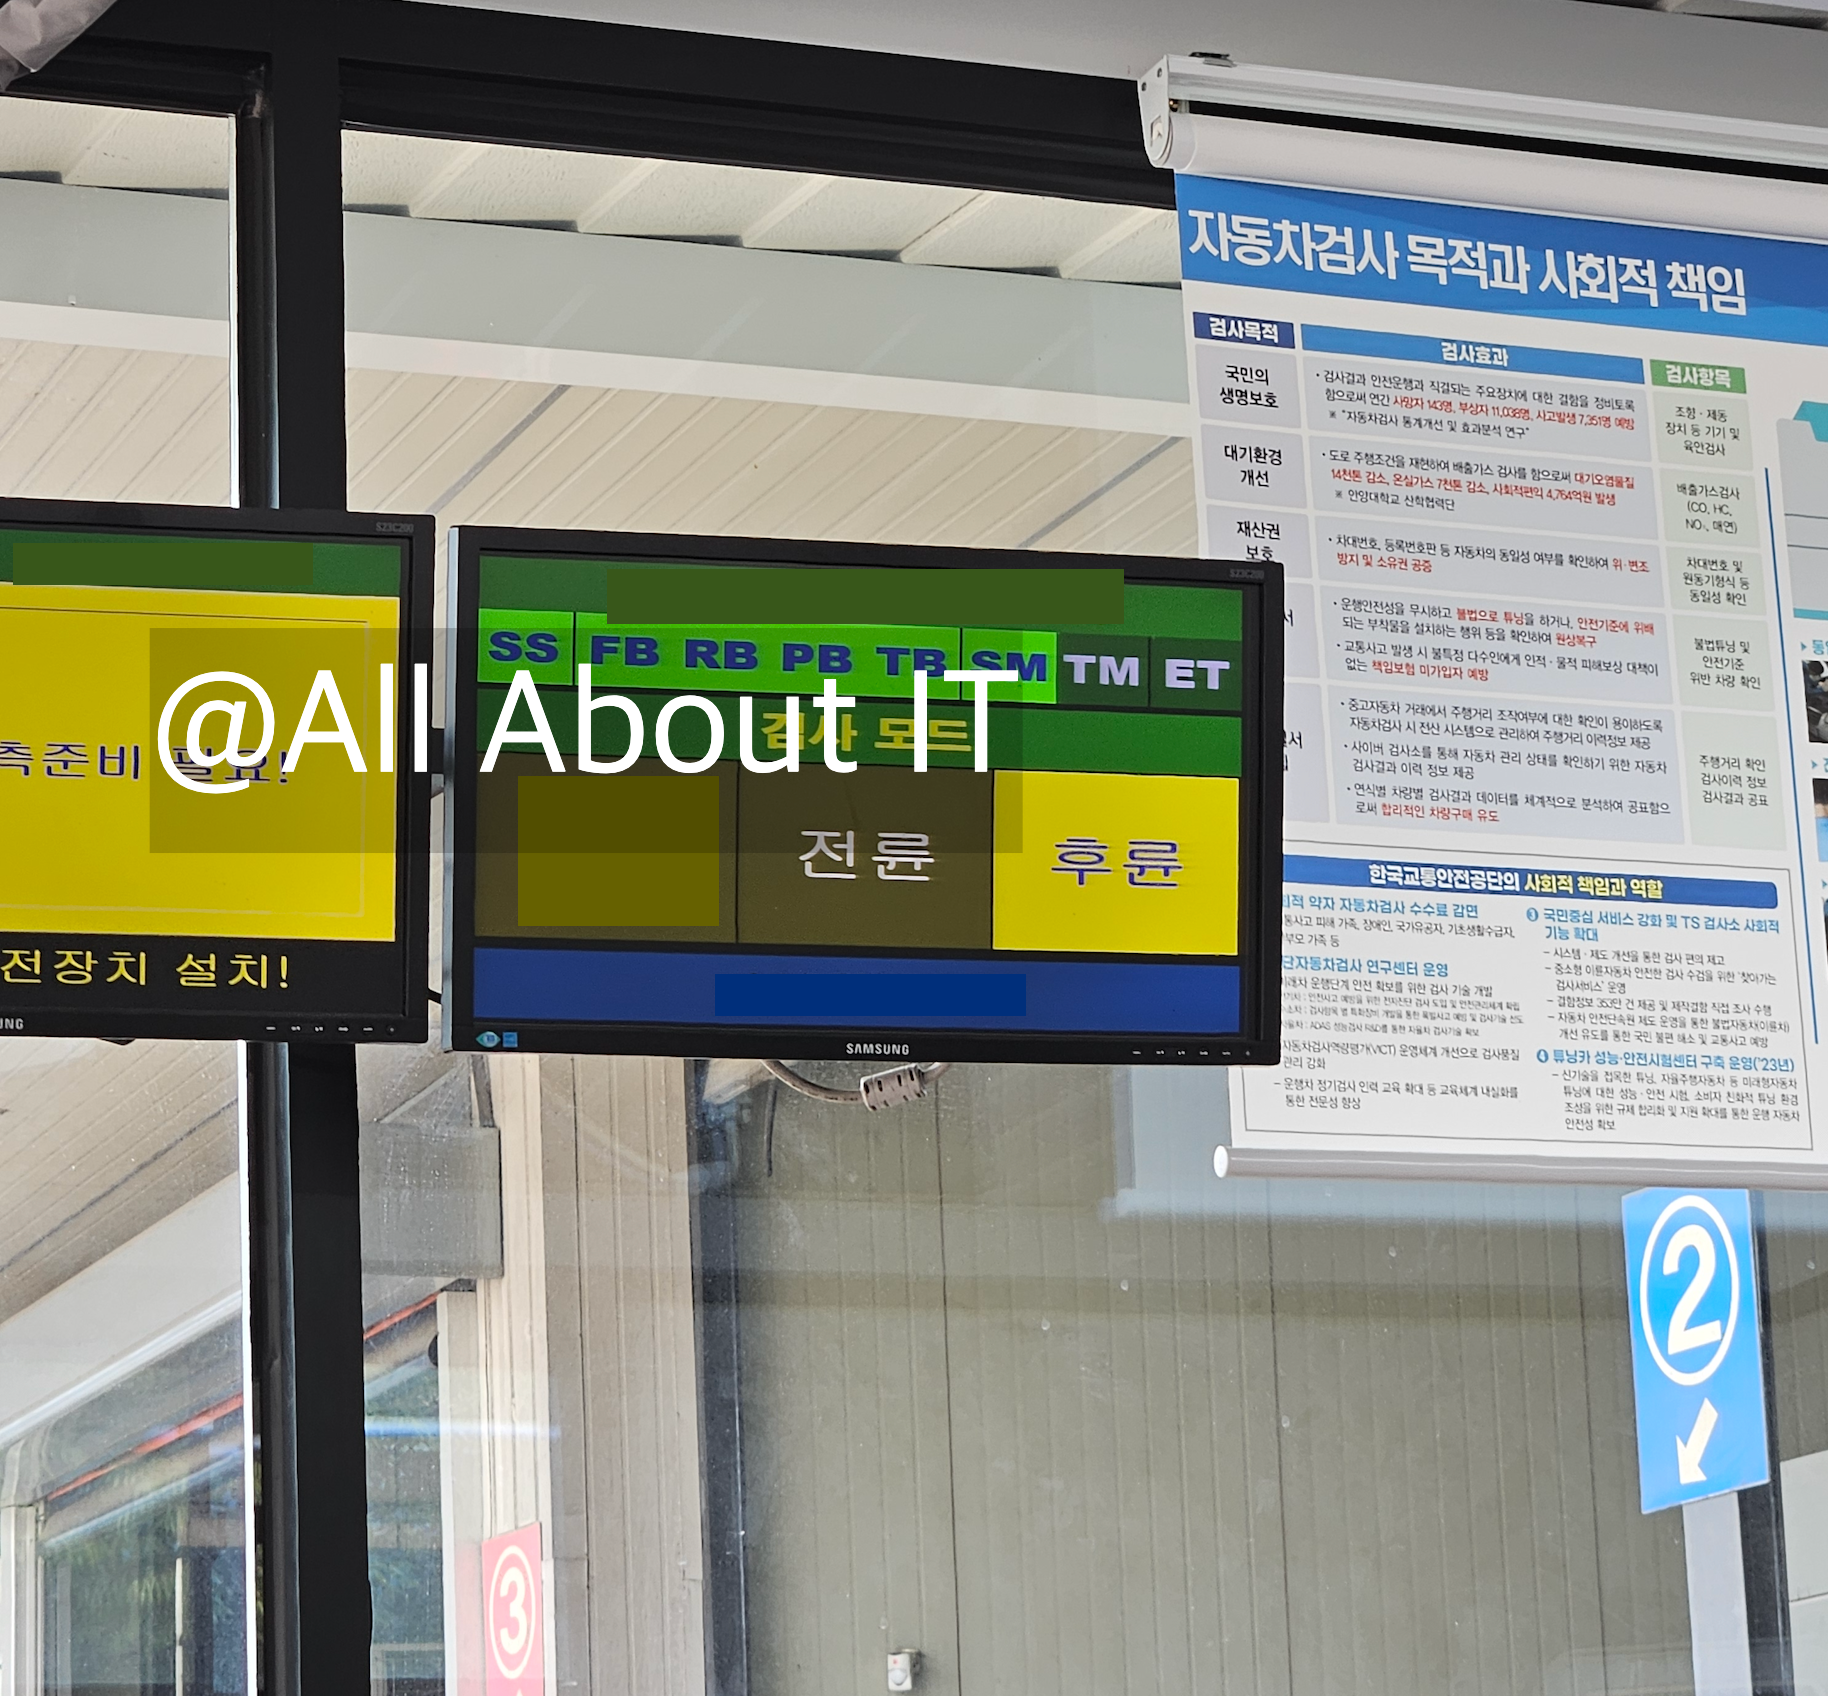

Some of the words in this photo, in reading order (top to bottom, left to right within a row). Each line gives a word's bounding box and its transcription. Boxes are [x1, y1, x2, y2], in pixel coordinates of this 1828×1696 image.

[1188, 209, 1400, 281] 자동차검사
[1407, 233, 1531, 294] 목적과
[1538, 249, 1659, 309] 사회적
[1666, 262, 1747, 316] 책임
[1209, 317, 1279, 344] 검사목적
[1441, 342, 1509, 367] 검사효과
[1225, 364, 1269, 386] 국민의
[1665, 365, 1731, 388] 검사항목
[1220, 387, 1279, 408] 생명보호
[1323, 370, 1366, 386] 검사결과
[1371, 376, 1424, 391] 안전운행과
[1429, 380, 1470, 397] 직결되는
[1476, 386, 1528, 403] 주요장치에
[1532, 392, 1554, 405] 대한
[1559, 394, 1589, 408] 결함을
[1594, 397, 1635, 412] 정비토록
[1325, 388, 1366, 406] 함으로써
[1369, 393, 1390, 407] 연간
[1393, 394, 1424, 411] 사망자
[1459, 403, 1489, 416] 부상자
[1536, 410, 1576, 425] 사고발생
[1615, 416, 1635, 431] 예방
[1675, 406, 1696, 419] 조향
[1707, 409, 1728, 423] 제동
[1665, 421, 1687, 435] 장치
[1691, 424, 1701, 437] 등
[1705, 426, 1726, 439] 기기
[1730, 428, 1740, 441] 및
[1224, 444, 1283, 466] 대기환경
[1683, 440, 1726, 456] 육안검사
[1241, 469, 1270, 488] 개선
[1329, 450, 1351, 462] 도로
[1354, 451, 1405, 469] 주행조건을
[1408, 456, 1450, 473] 재현하여
[1453, 462, 1494, 476] 배출가스
[1497, 465, 1527, 479] 검사를
[1531, 468, 1572, 484] 함으로써
[1575, 472, 1635, 490] 대기오염물질
[1331, 468, 1362, 483] 14천톤
[1393, 474, 1434, 489] 온실가스
[1437, 478, 1463, 492] 7천톤
[1493, 483, 1544, 500] 사회적편익
[1595, 491, 1616, 506] 발생
[1677, 483, 1740, 500] 배출가스검사
[1348, 489, 1400, 506] 안양대학교
[1404, 494, 1455, 512] 산학협력단
[1236, 520, 1281, 541] 재산권
[1713, 521, 1738, 535] 매연)
[1246, 545, 1275, 562] 보호
[1337, 552, 1359, 567] 방지
[1362, 554, 1373, 568] 및
[1377, 555, 1408, 570] 소유권
[1412, 558, 1433, 571] 공증
[1384, 539, 1437, 555] 등록번호판
[1440, 543, 1450, 557] 등
[1454, 545, 1496, 560] 자동차의
[1499, 549, 1531, 564] 동일성
[1533, 551, 1564, 565] 여부를
[1568, 554, 1609, 570] 확인하여
[1686, 556, 1729, 571] 차대번호
[1733, 560, 1743, 573] 및
[1683, 572, 1735, 588] 원동기형식
[1740, 577, 1750, 590] 등
[1689, 589, 1721, 604] 동일성
[1726, 592, 1747, 607] 확인
[1694, 638, 1736, 653] 불법튜닝
[1740, 641, 1750, 654] 및
[489, 631, 559, 663] SS
[591, 635, 659, 667] FB
[684, 638, 759, 671] RB
[782, 642, 853, 674] PB
[875, 645, 947, 676] TB
[970, 650, 1048, 683] SM
[1063, 654, 1139, 687] TM
[1164, 658, 1231, 690] ET
[1345, 658, 1368, 672] 없는
[1372, 660, 1415, 676] 책임보험
[1420, 664, 1463, 680] 미가입자
[1468, 668, 1489, 681] 예방
[1702, 656, 1745, 671] 안전기준
[1690, 672, 1711, 685] 위반
[1715, 674, 1735, 688] 차량
[1740, 676, 1761, 690] 확인
[874, 716, 972, 752] 모드
[0, 740, 140, 780] 축준비
[1353, 760, 1397, 774] 검사결과
[1401, 762, 1423, 776] 이력
[1427, 764, 1449, 778] 정보
[1453, 766, 1475, 780] 제공
[1699, 755, 1741, 770] 주행거리
[1745, 758, 1766, 772] 확인
[1701, 773, 1743, 788] 검사이력
[1747, 776, 1767, 788] 정보
[1702, 790, 1744, 805] 검사결과
[1748, 793, 1769, 806] 공표
[799, 829, 935, 883] 전륜
[1051, 836, 1184, 888] 후륜
[1369, 864, 1521, 892] 한국교통안전공단의
[1525, 872, 1573, 894] 사회적
[1577, 876, 1627, 897] 책임과
[1630, 879, 1664, 899] 역할
[1309, 896, 1335, 910] 약자
[1340, 898, 1405, 915] 자동차검사
[1410, 902, 1449, 917] 수수료
[1454, 904, 1479, 918] 감면
[1544, 908, 1594, 925] 국민중심
[1597, 911, 1635, 926] 서비스
[1637, 913, 1662, 928] 강화
[1666, 915, 1677, 929] 및
[1682, 915, 1701, 929] TS
[1704, 917, 1740, 932] 검사소
[1744, 919, 1780, 934] 사회적
[1546, 925, 1569, 941] 기능
[1574, 927, 1599, 942] 확대
[0, 949, 146, 986] 전장치
[176, 953, 288, 989] 설치!
[1367, 960, 1418, 976] 연구센터
[1423, 963, 1449, 977] 운영
[846, 1042, 909, 1055] SAMSUNG
[1284, 1057, 1303, 1069] 관리
[1306, 1058, 1326, 1070] 강화
[1553, 1050, 1590, 1065] 튜닝카
[1701, 1055, 1725, 1069] 구축
[1285, 1095, 1305, 1107] 통한
[1309, 1096, 1338, 1109] 전문성
[1342, 1098, 1361, 1110] 향상
[1565, 1118, 1594, 1130] 안전성
[1597, 1119, 1616, 1130] 확보
[1663, 1224, 1721, 1355] 2
[500, 1567, 527, 1654] 3
